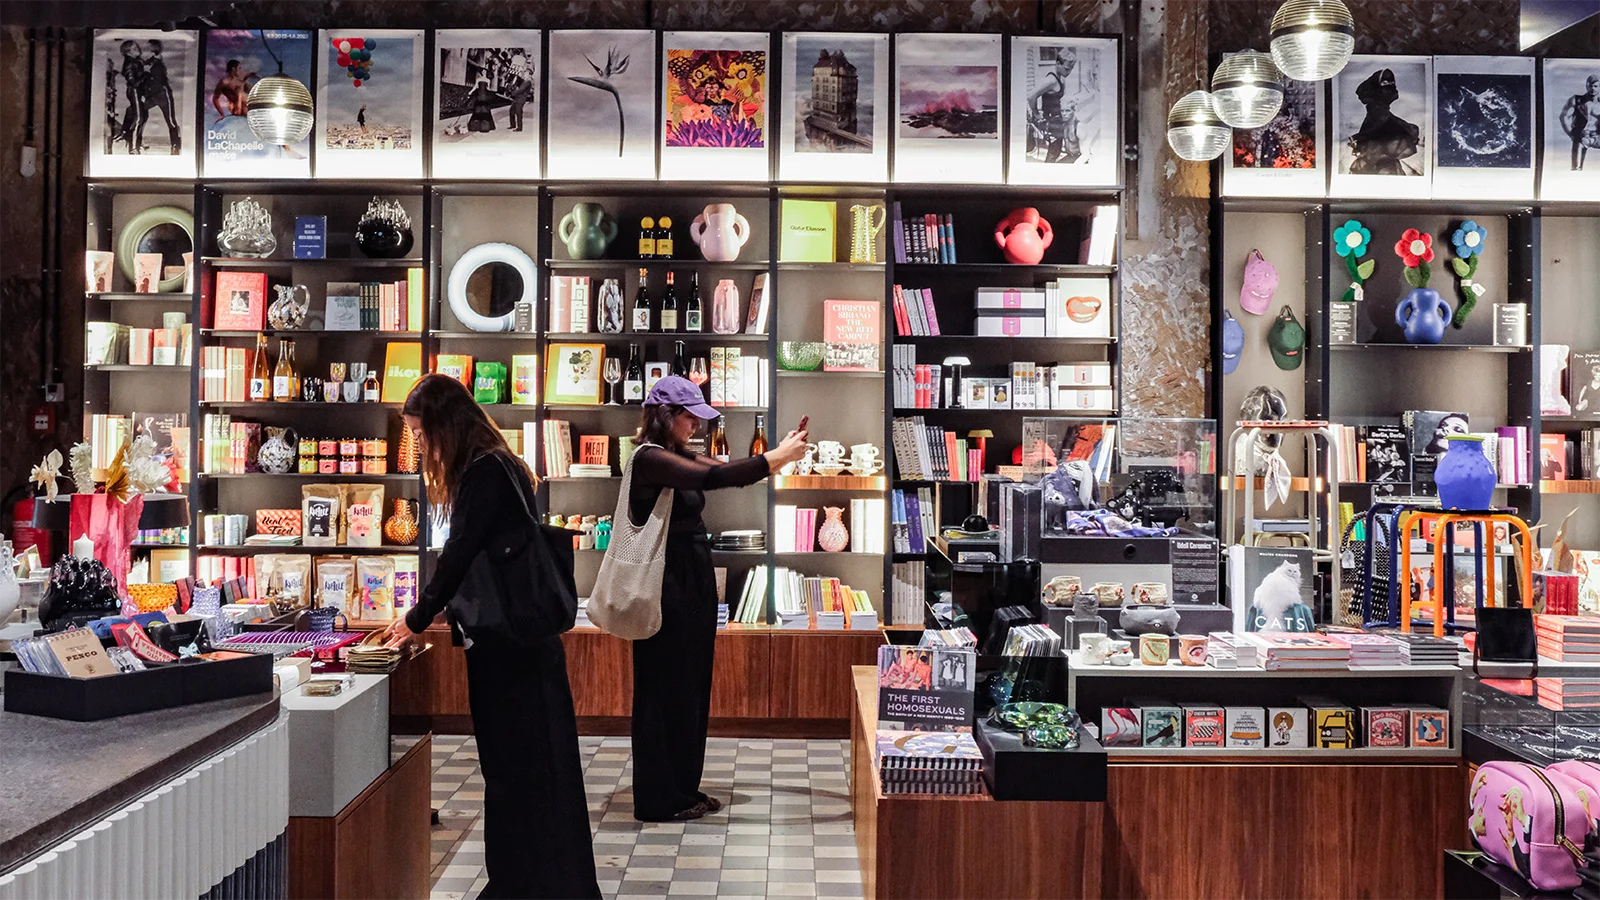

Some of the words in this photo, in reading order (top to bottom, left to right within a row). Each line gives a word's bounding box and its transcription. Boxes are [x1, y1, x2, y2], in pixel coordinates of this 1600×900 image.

[208, 130, 236, 140] David
[208, 141, 264, 152] LaChapelle
[832, 304, 877, 312] CHRISTIAN
[838, 311, 871, 319] SIRIANO
[836, 325, 853, 333] NEW
[585, 442, 605, 456] MEAT
[1255, 615, 1305, 631] CATS
[65, 650, 98, 662] PENCO
[887, 693, 908, 703] THE
[911, 695, 941, 704] FIRST
[887, 703, 966, 715] HOMOSEXUALS
[1372, 713, 1385, 721] TWO
[1385, 712, 1402, 720] ROSES
[1374, 738, 1401, 747] TOGETHER
